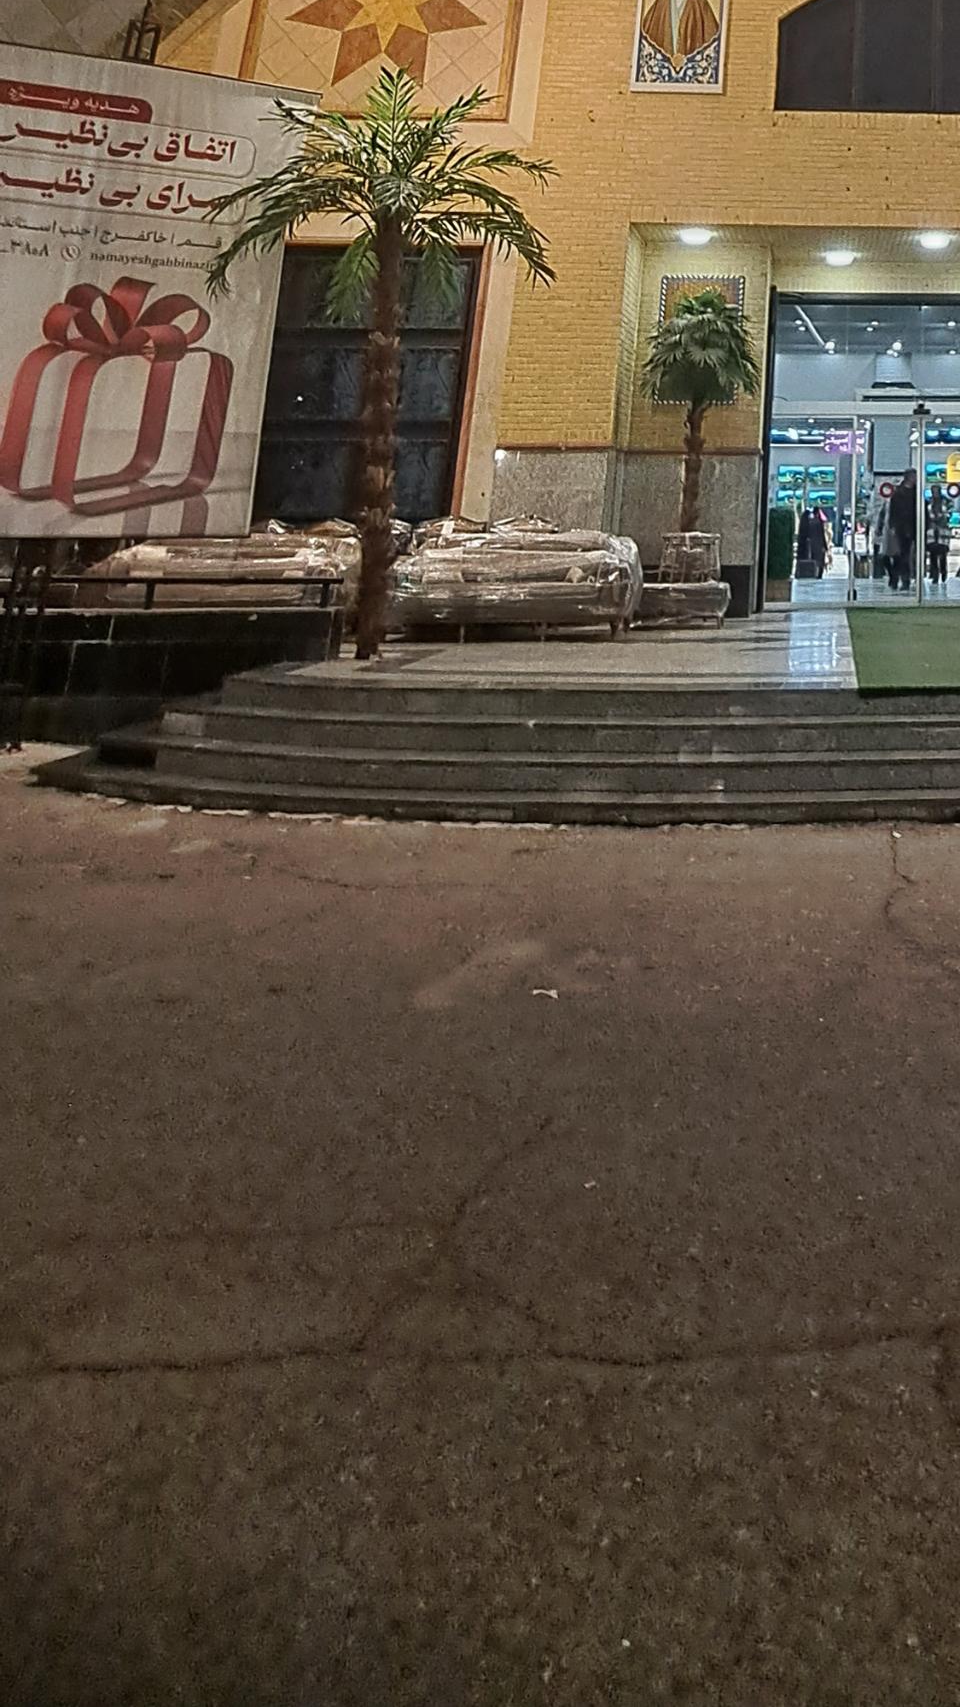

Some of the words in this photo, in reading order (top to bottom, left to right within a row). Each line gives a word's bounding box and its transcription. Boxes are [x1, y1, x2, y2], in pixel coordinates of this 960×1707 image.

[8, 85, 80, 111] ویژه
[85, 93, 141, 115] هدیه
[153, 132, 238, 164] اتفاق
[98, 183, 142, 208] بی
